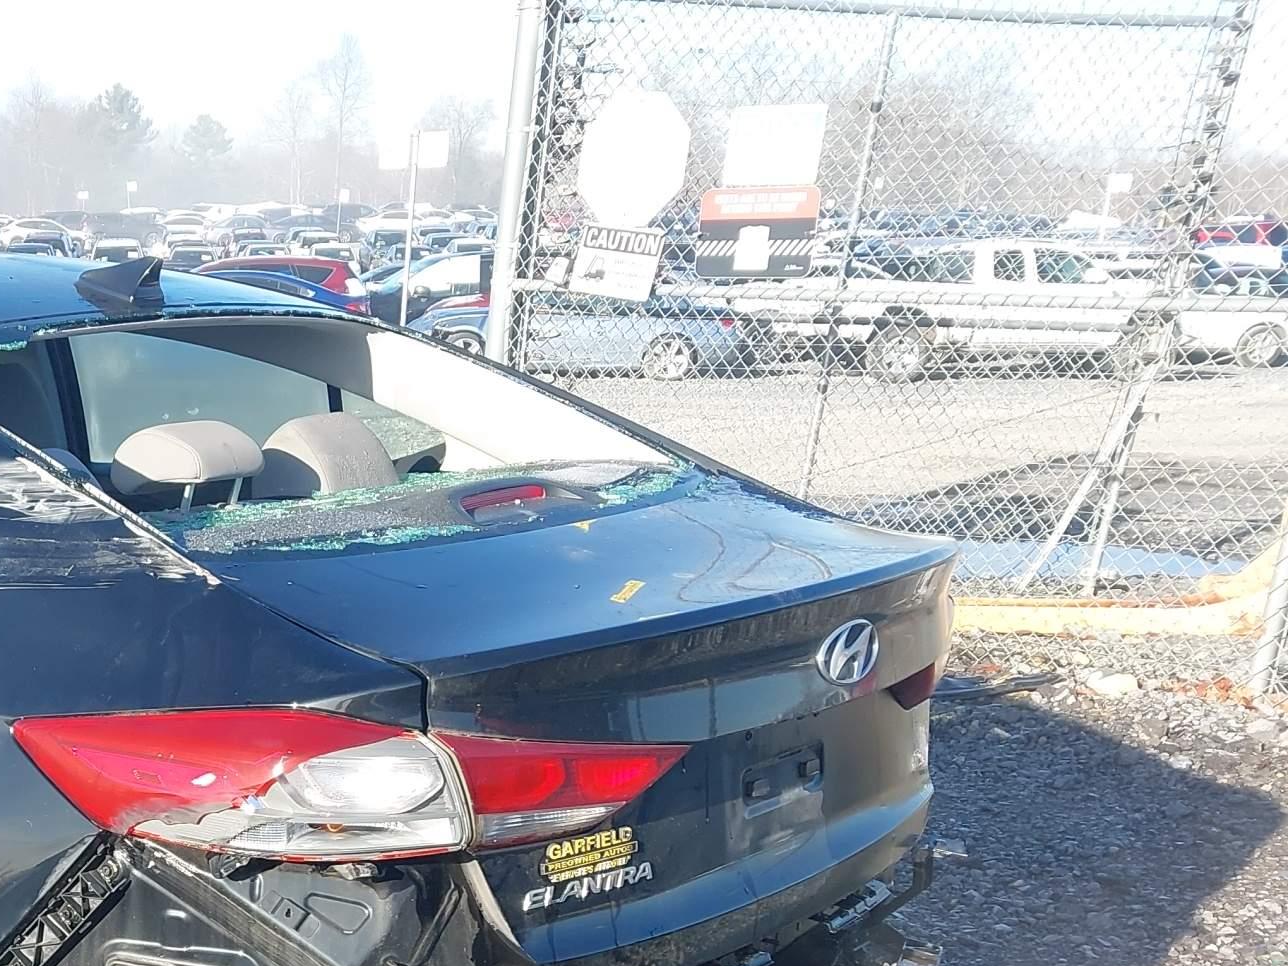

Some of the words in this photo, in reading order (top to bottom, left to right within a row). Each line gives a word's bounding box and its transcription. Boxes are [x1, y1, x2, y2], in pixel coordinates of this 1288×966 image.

[585, 226, 660, 255] CAUTION
[546, 827, 633, 860] GARFIELD
[548, 853, 601, 872] PREOWNED
[602, 843, 634, 859] AUTOS
[522, 861, 654, 911] ELANTRA
